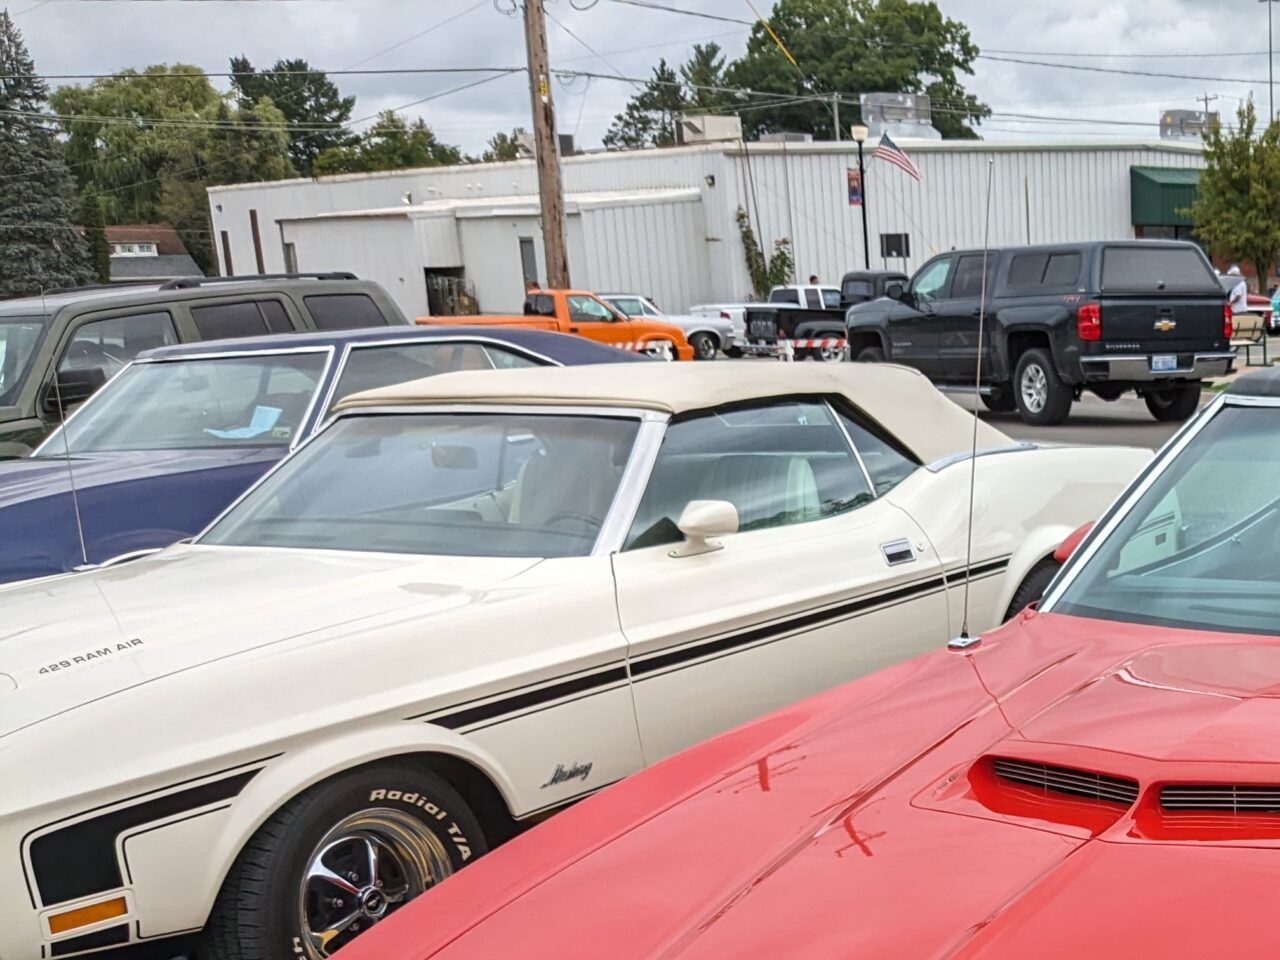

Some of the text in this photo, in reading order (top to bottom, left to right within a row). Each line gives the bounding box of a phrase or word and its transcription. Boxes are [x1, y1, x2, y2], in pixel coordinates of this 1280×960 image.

[38, 638, 144, 674] 429 RAM AIR
[369, 789, 472, 861] Radial T/A
